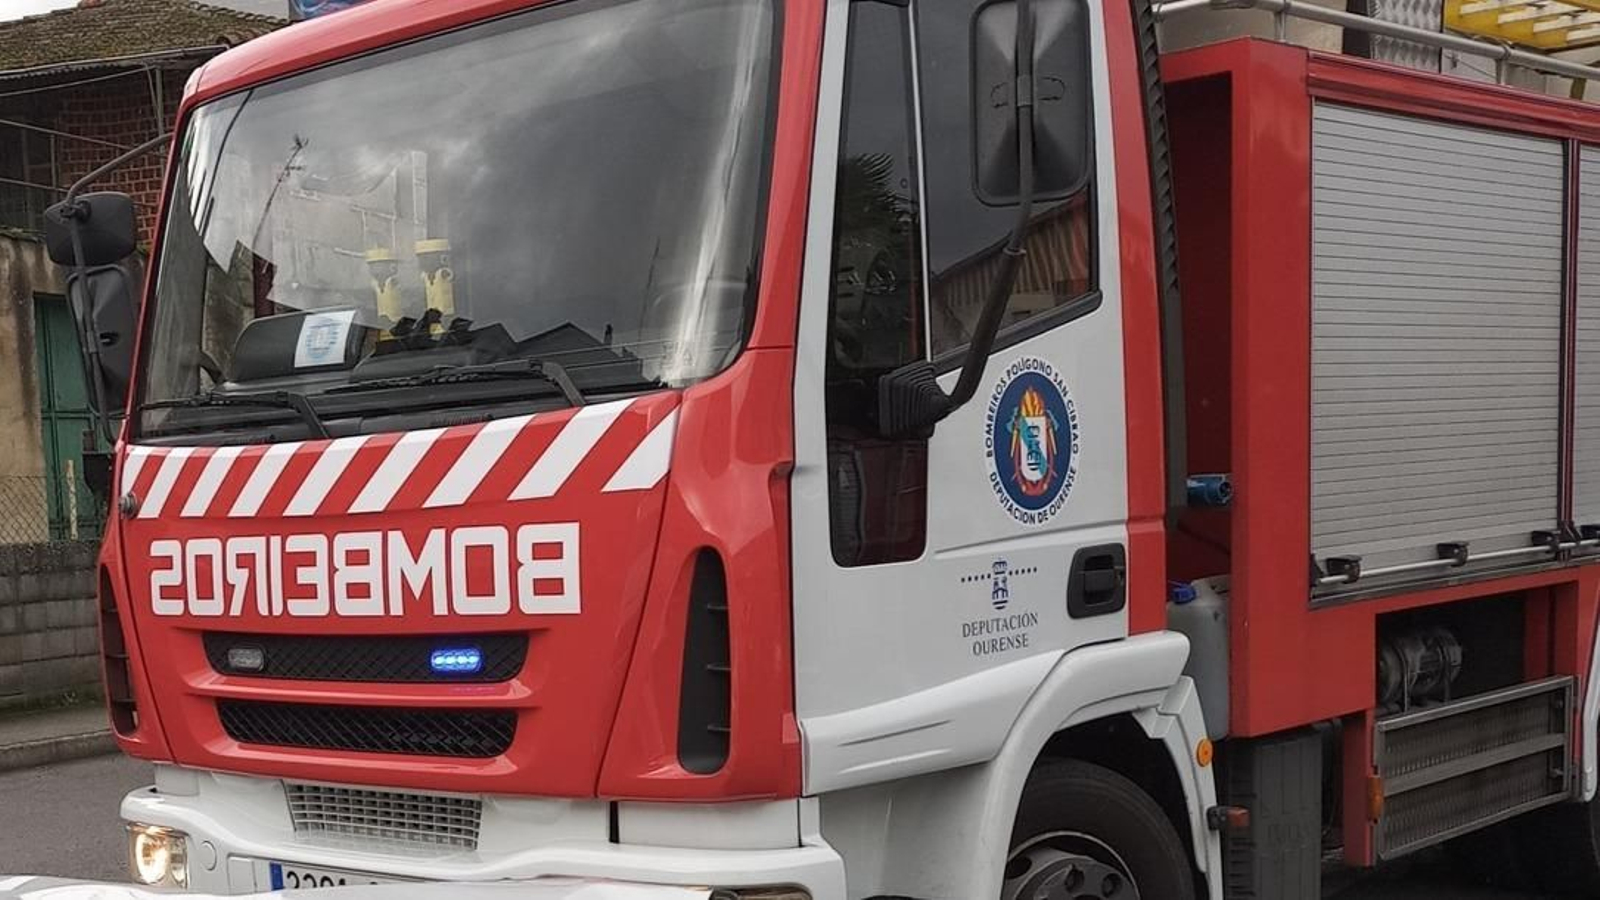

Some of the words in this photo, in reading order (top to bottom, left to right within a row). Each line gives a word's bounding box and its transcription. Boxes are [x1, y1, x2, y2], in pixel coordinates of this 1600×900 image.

[985, 377, 1007, 458] BOMBEIROS
[1006, 357, 1052, 381] POLÍGONO
[1053, 372, 1069, 398] SAN
[1066, 400, 1079, 455] CIBRAO
[1037, 510, 1049, 523] DE
[1050, 468, 1077, 516] OURENSE
[972, 632, 1029, 656] OURENSE
